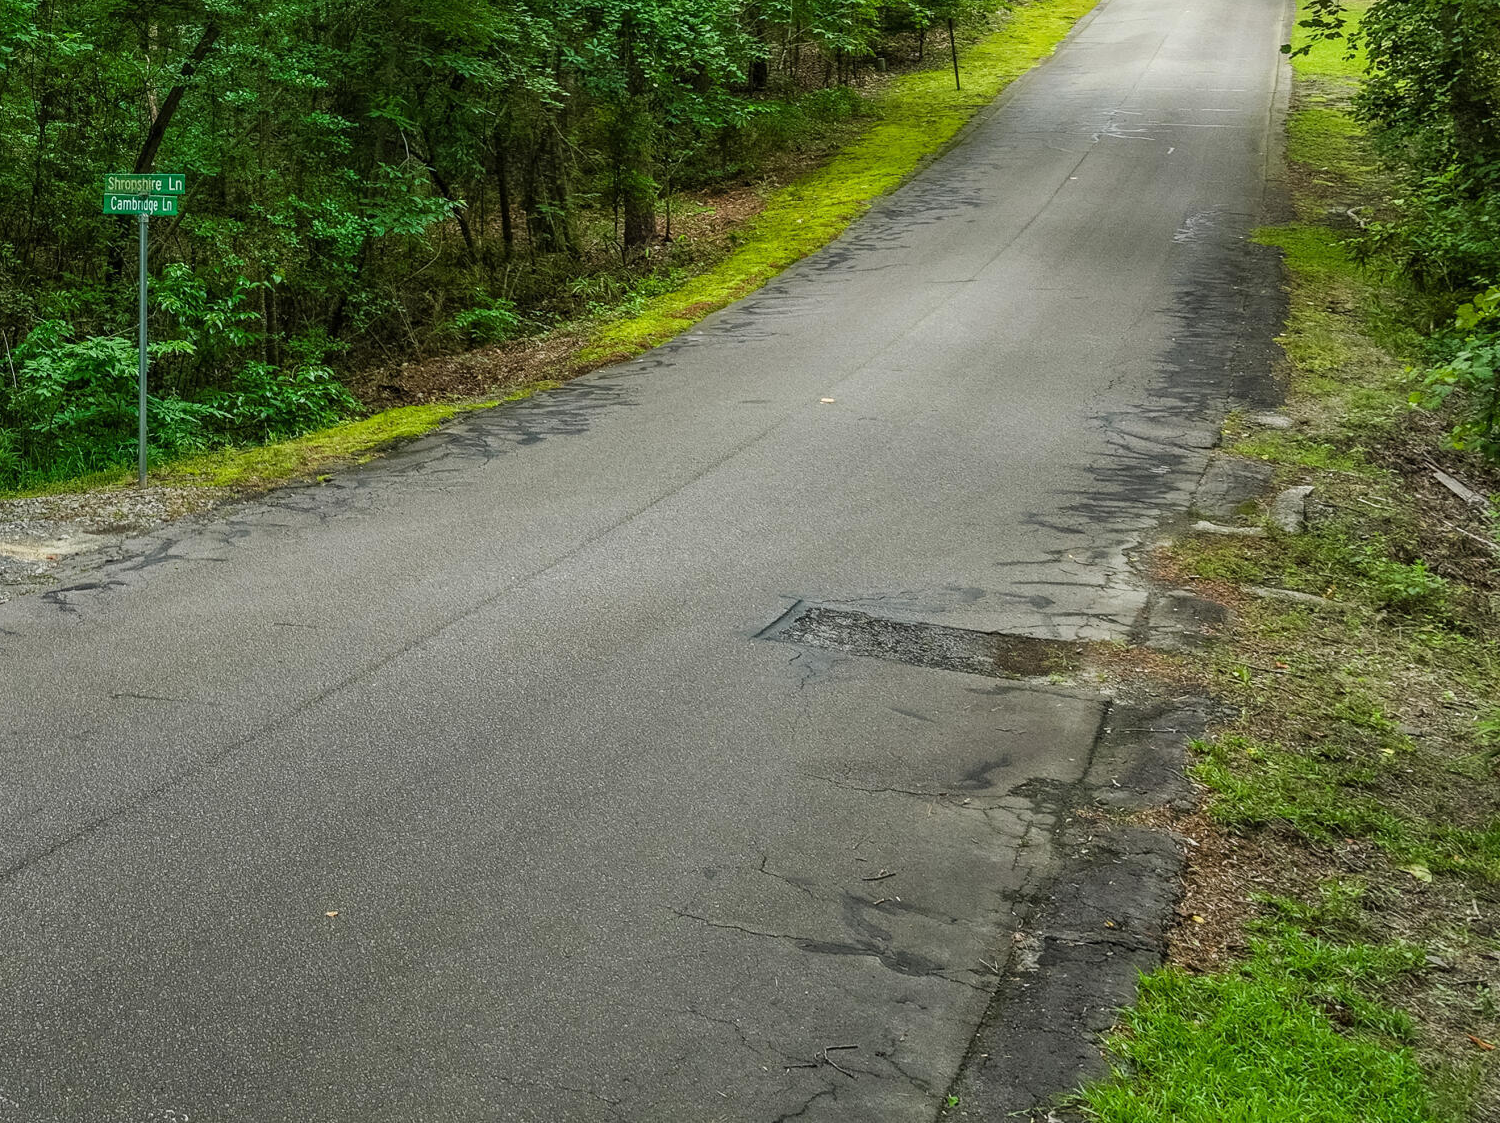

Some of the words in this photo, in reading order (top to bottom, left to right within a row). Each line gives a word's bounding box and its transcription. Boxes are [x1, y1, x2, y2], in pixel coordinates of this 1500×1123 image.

[108, 176, 162, 192] Shropshire
[168, 176, 183, 191] Ln
[110, 196, 158, 215] Cambridge
[162, 197, 172, 211] Ln
